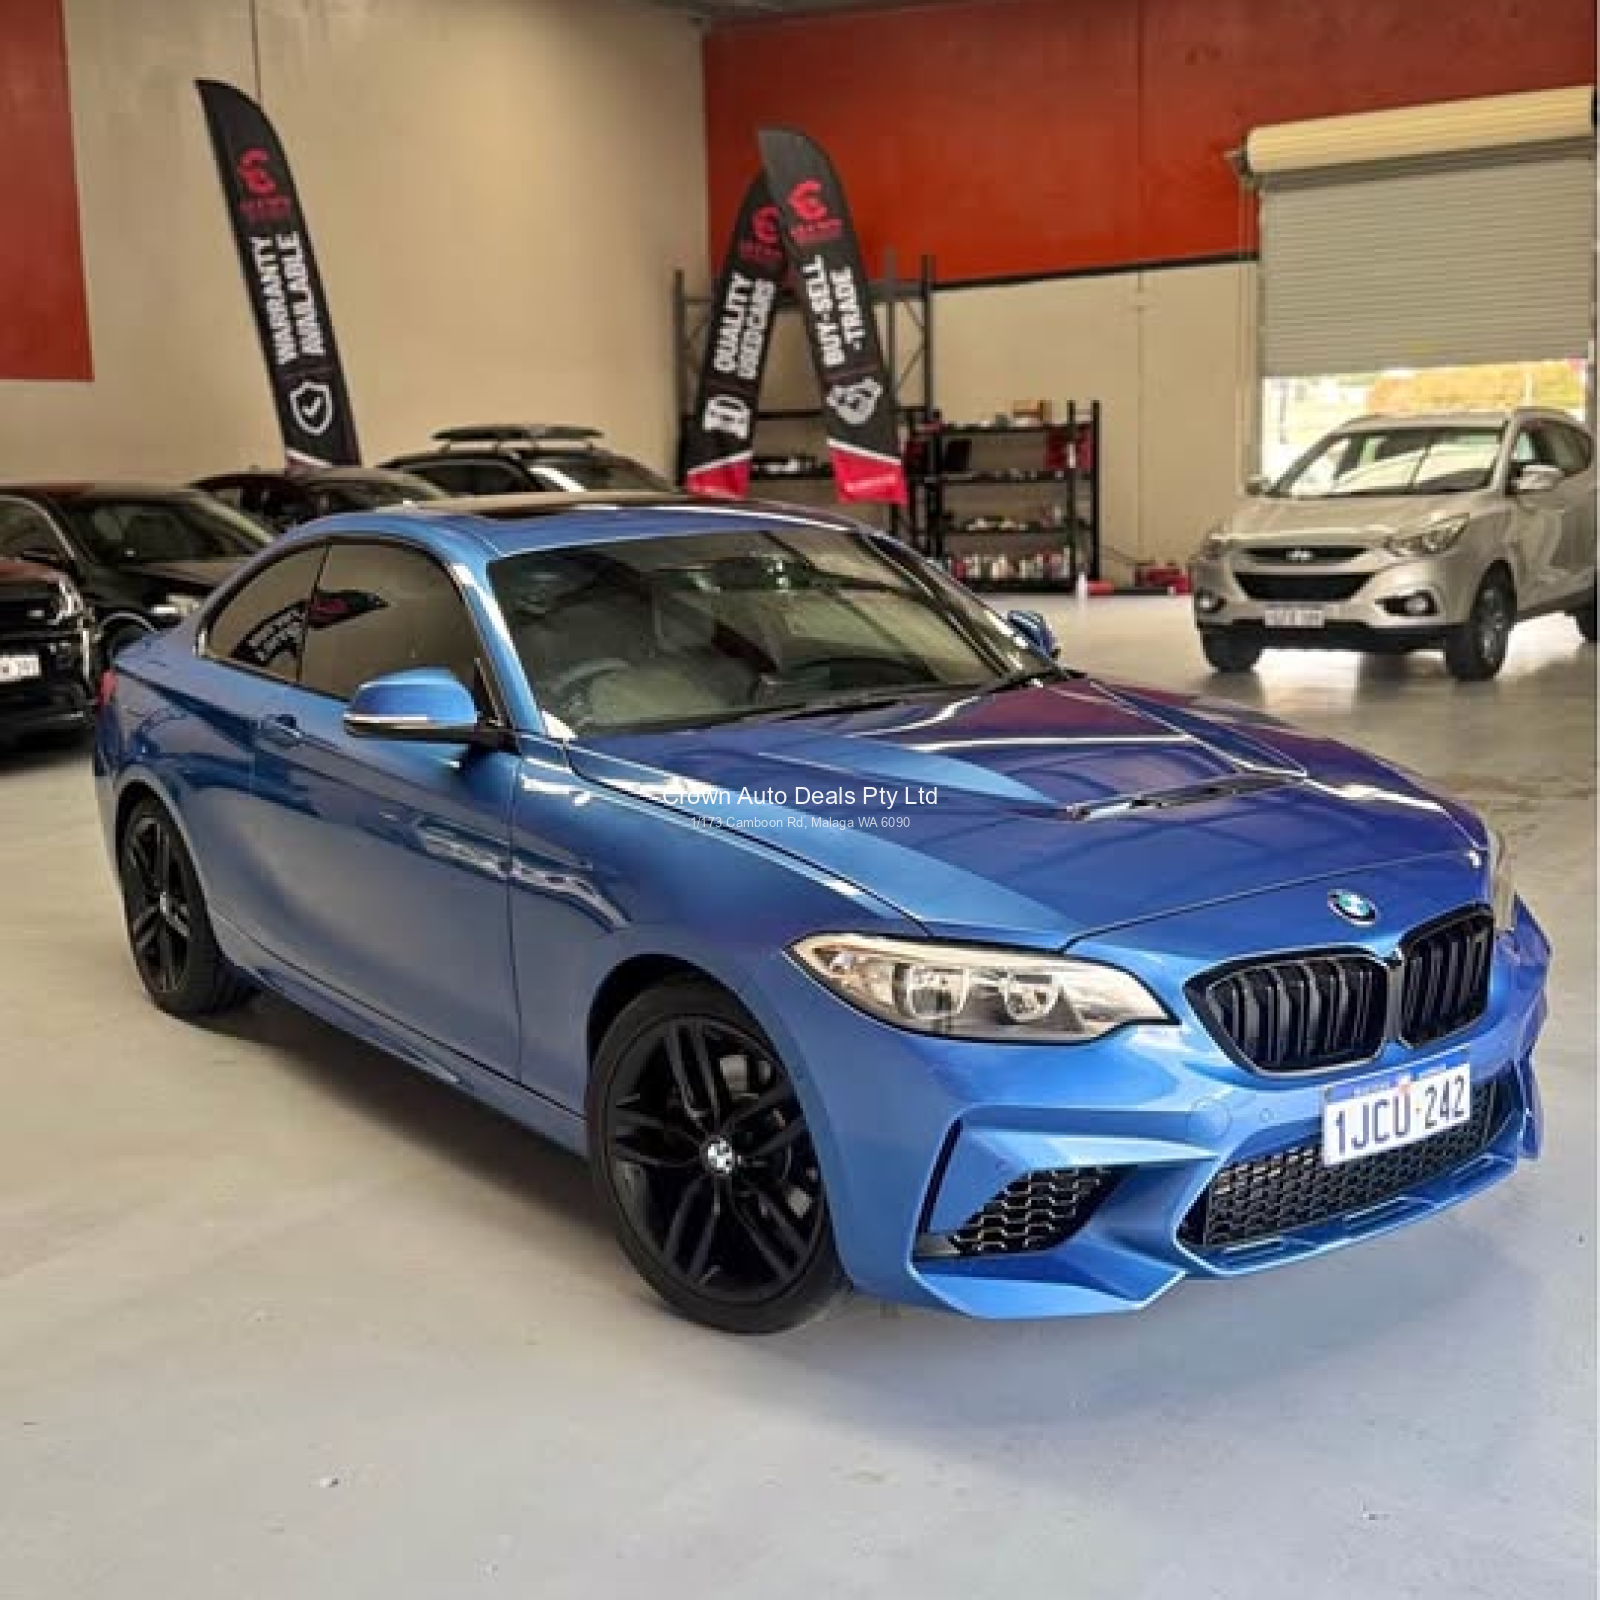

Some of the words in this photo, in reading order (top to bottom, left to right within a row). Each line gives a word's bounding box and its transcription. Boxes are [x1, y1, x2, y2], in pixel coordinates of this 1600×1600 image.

[250, 236, 299, 365] WARRANTY
[275, 230, 326, 356] AVAILABLE
[713, 271, 753, 372] QUALITY
